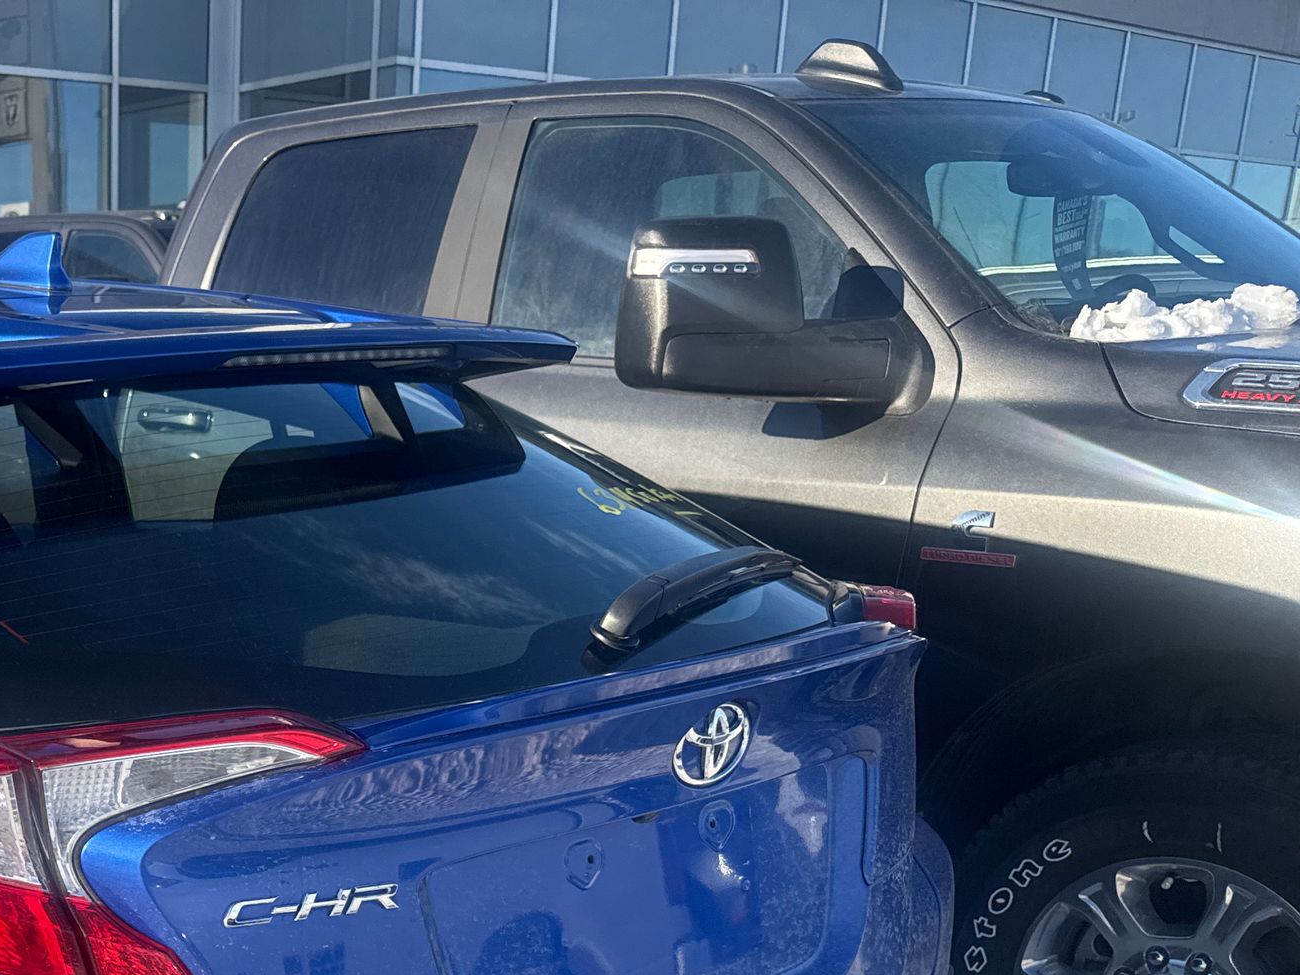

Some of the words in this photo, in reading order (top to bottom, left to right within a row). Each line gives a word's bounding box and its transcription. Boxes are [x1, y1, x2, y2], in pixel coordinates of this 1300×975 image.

[1057, 209, 1077, 226] BEST
[1054, 226, 1086, 244] WARRANTY
[1221, 390, 1297, 403] HEAVY
[223, 882, 400, 928] C-HR
